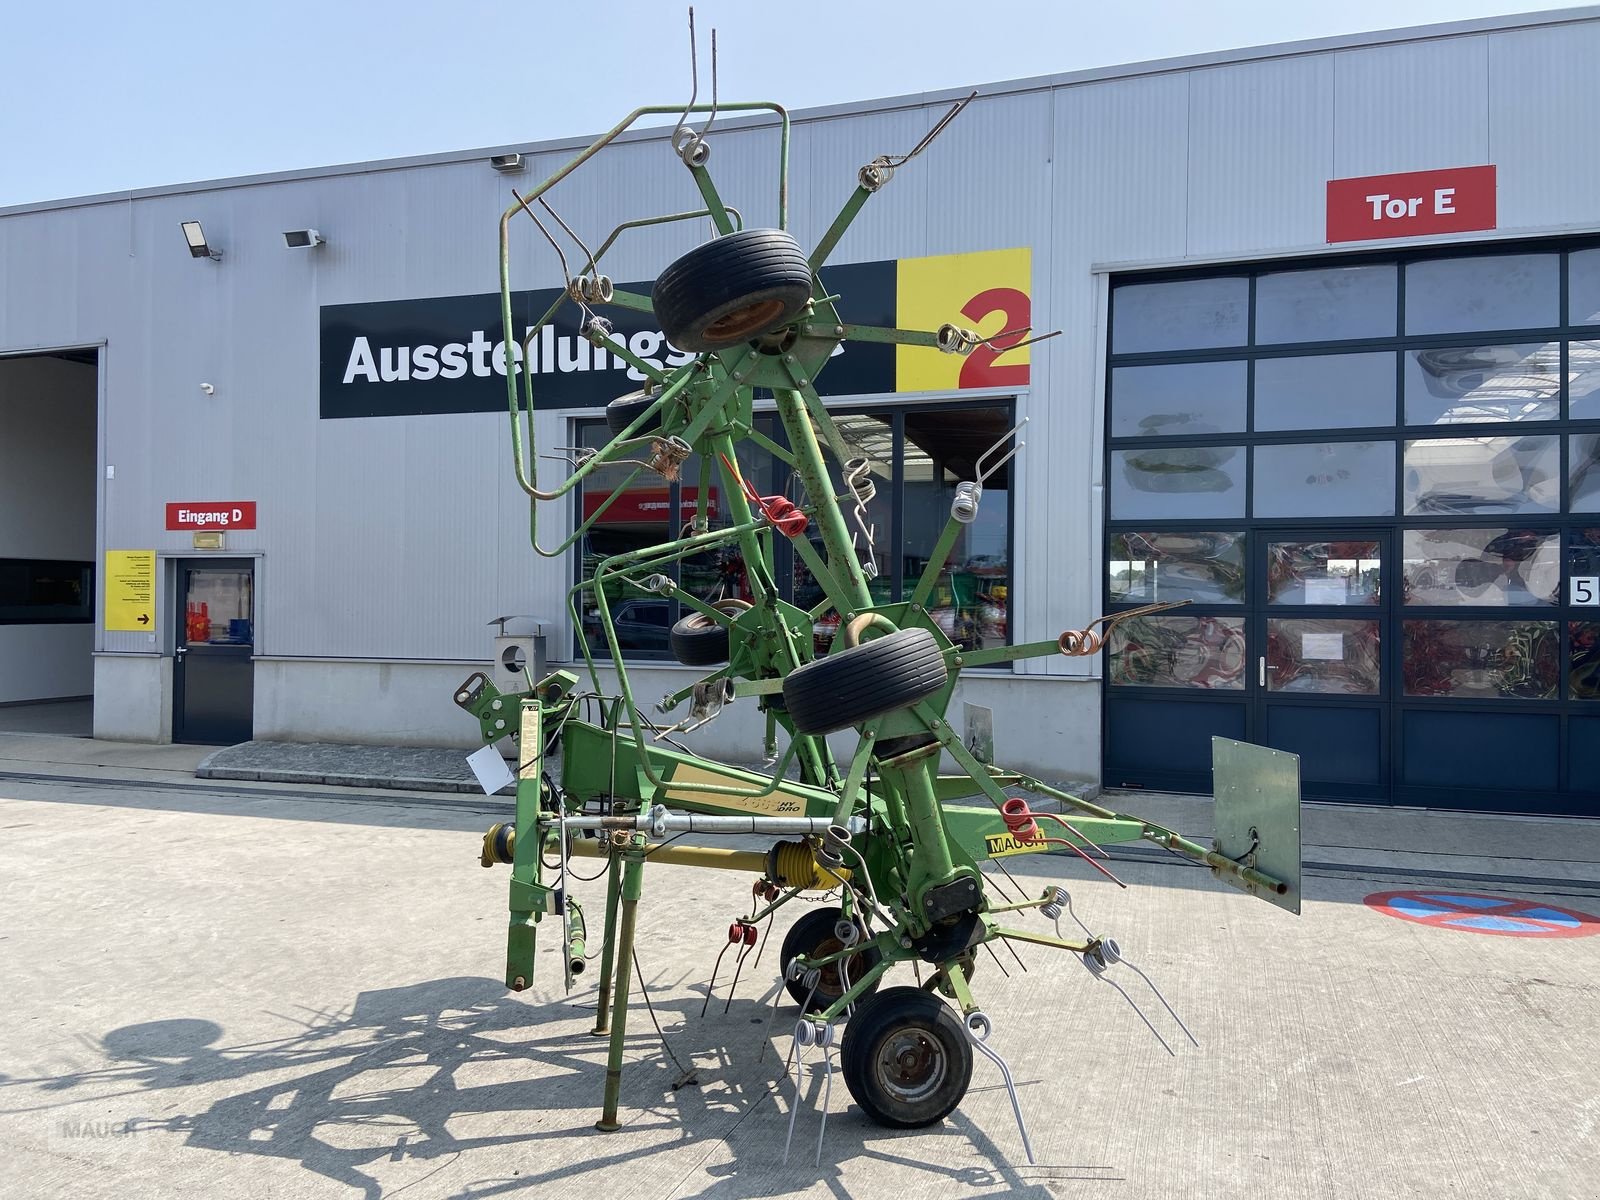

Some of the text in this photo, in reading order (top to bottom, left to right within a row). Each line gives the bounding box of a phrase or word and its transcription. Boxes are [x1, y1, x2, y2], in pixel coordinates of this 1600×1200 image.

[1366, 188, 1456, 220] Tor E
[342, 287, 1031, 389] Ausstellungs 2
[178, 509, 242, 526] Eingang D
[1575, 580, 1592, 604] 5
